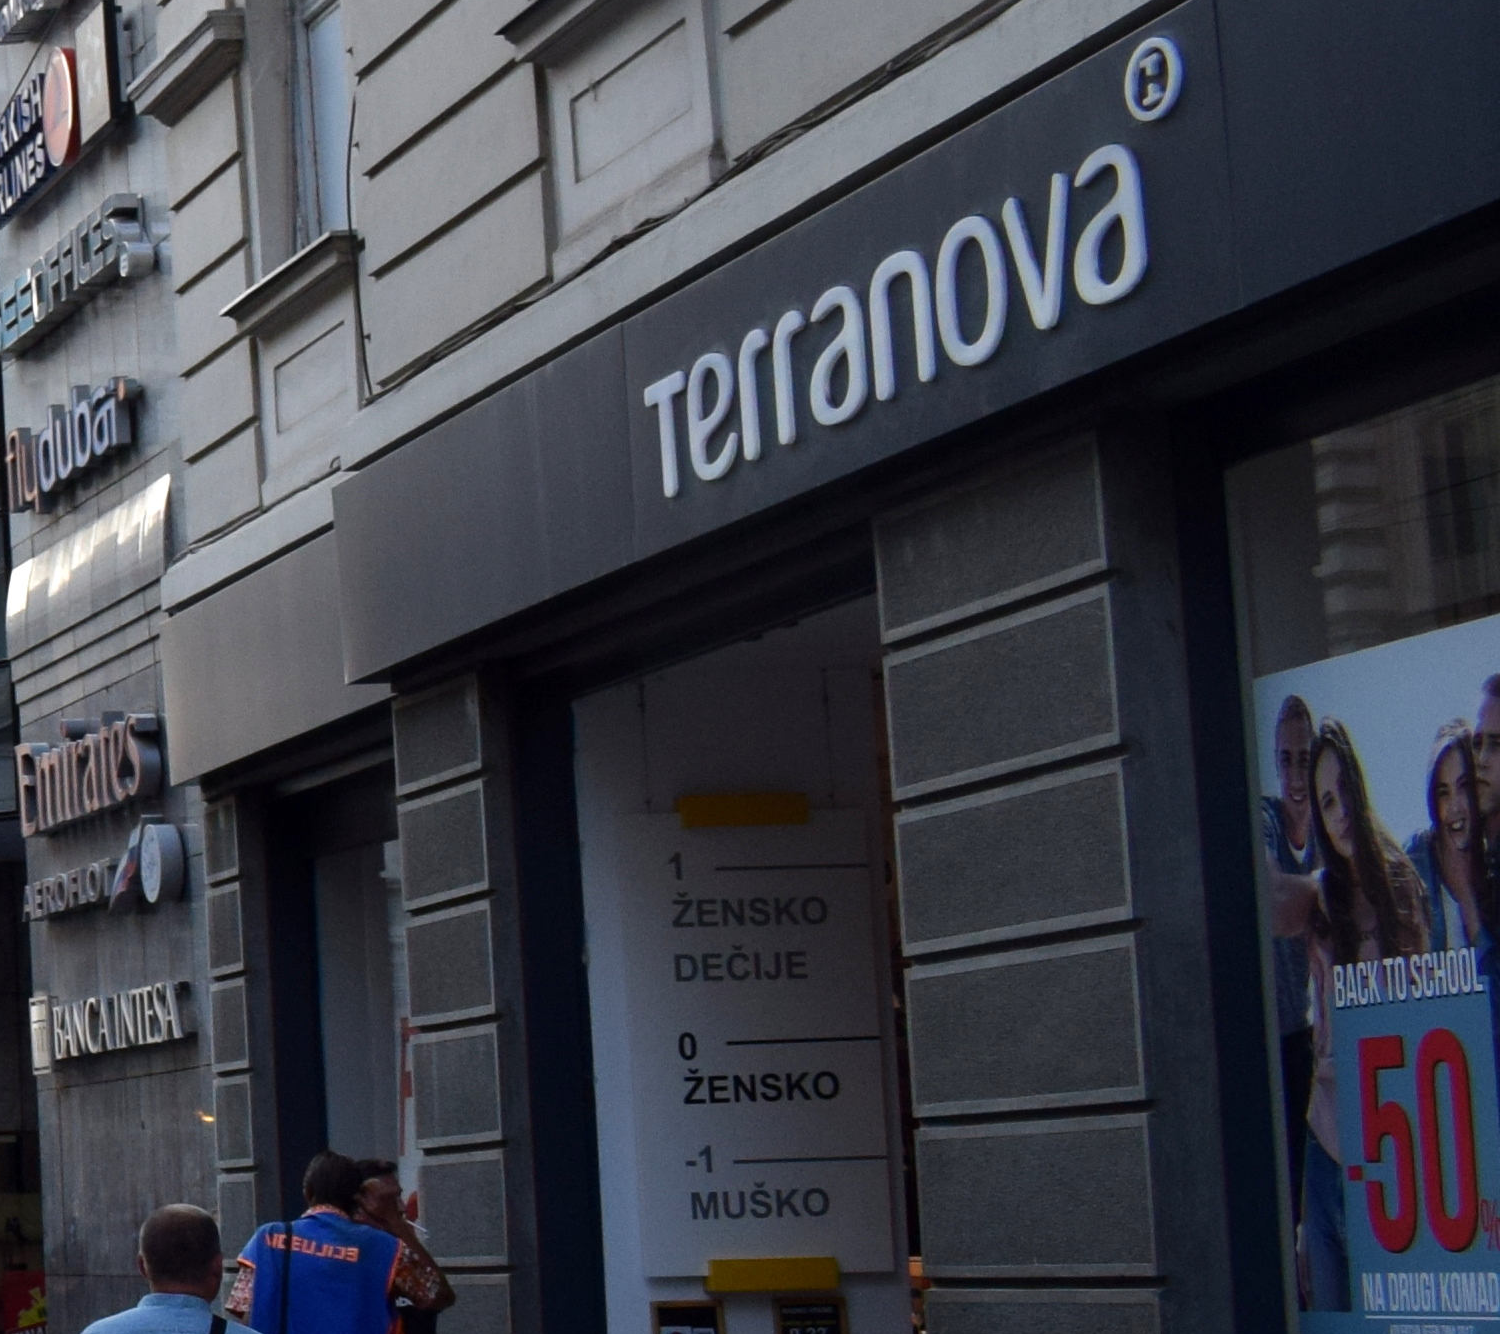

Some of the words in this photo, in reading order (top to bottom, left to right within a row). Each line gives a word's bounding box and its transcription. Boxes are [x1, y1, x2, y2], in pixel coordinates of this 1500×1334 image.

[4, 379, 128, 513] flydubai
[14, 712, 141, 838] Emirates
[668, 853, 684, 881] 1
[22, 856, 113, 923] AEROFLOT
[671, 894, 829, 929] ŽENSKO
[673, 948, 810, 983] DEČIJE
[1332, 960, 1383, 1009] BACK
[1383, 956, 1408, 1004] TO
[1409, 946, 1485, 1000] SCHOOL
[51, 995, 113, 1059] BANCA
[113, 981, 185, 1049] INTESA
[678, 1033, 699, 1063] 0
[683, 1067, 841, 1106] ŽENSKO
[684, 1146, 715, 1176] -1
[690, 1181, 831, 1221] MUŠKO
[1361, 1271, 1386, 1312] NA
[1387, 1271, 1438, 1313] DRUGI
[1439, 1271, 1500, 1313] KOMAD
